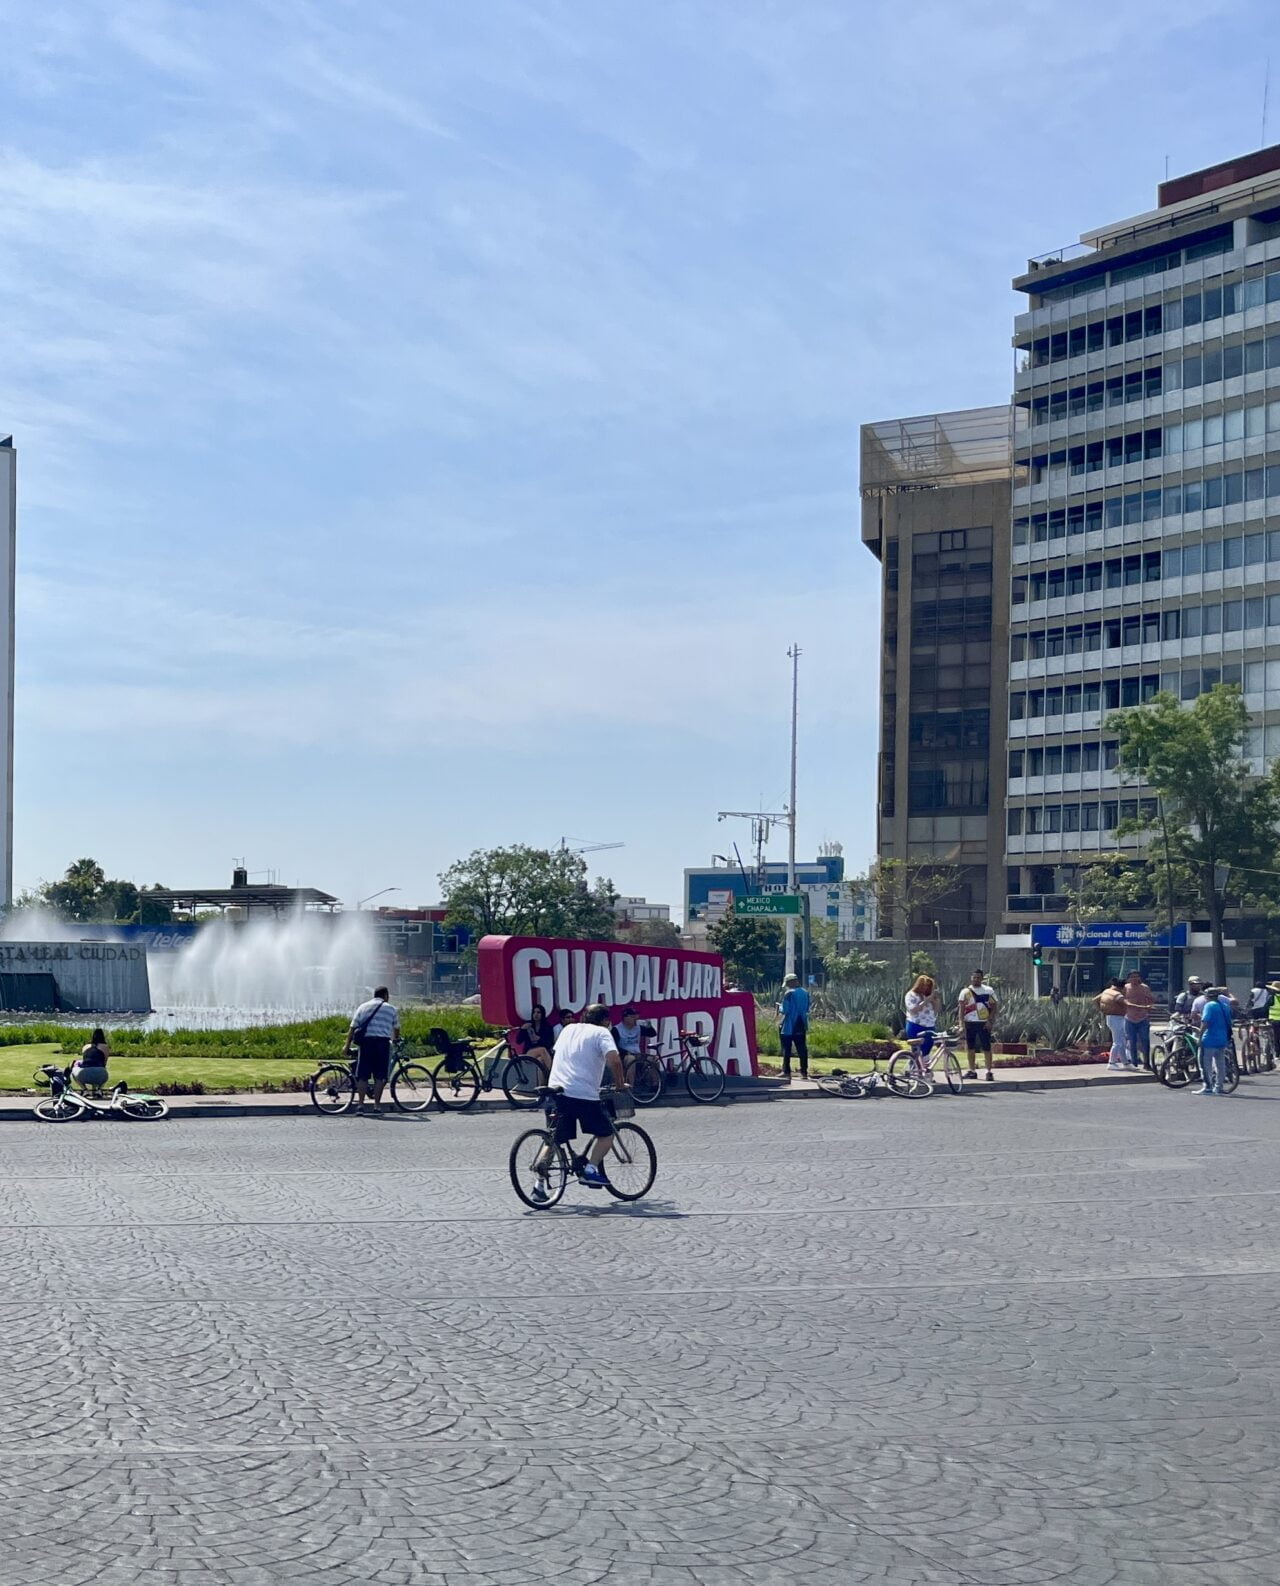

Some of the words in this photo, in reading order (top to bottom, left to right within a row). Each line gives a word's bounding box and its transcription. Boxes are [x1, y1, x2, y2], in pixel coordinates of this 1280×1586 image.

[746, 905, 778, 913] CHAPALA
[153, 932, 194, 948] telce
[1113, 930, 1124, 938] de
[80, 947, 141, 960] CIUDAD
[512, 947, 722, 1021] GUADALAJARA
